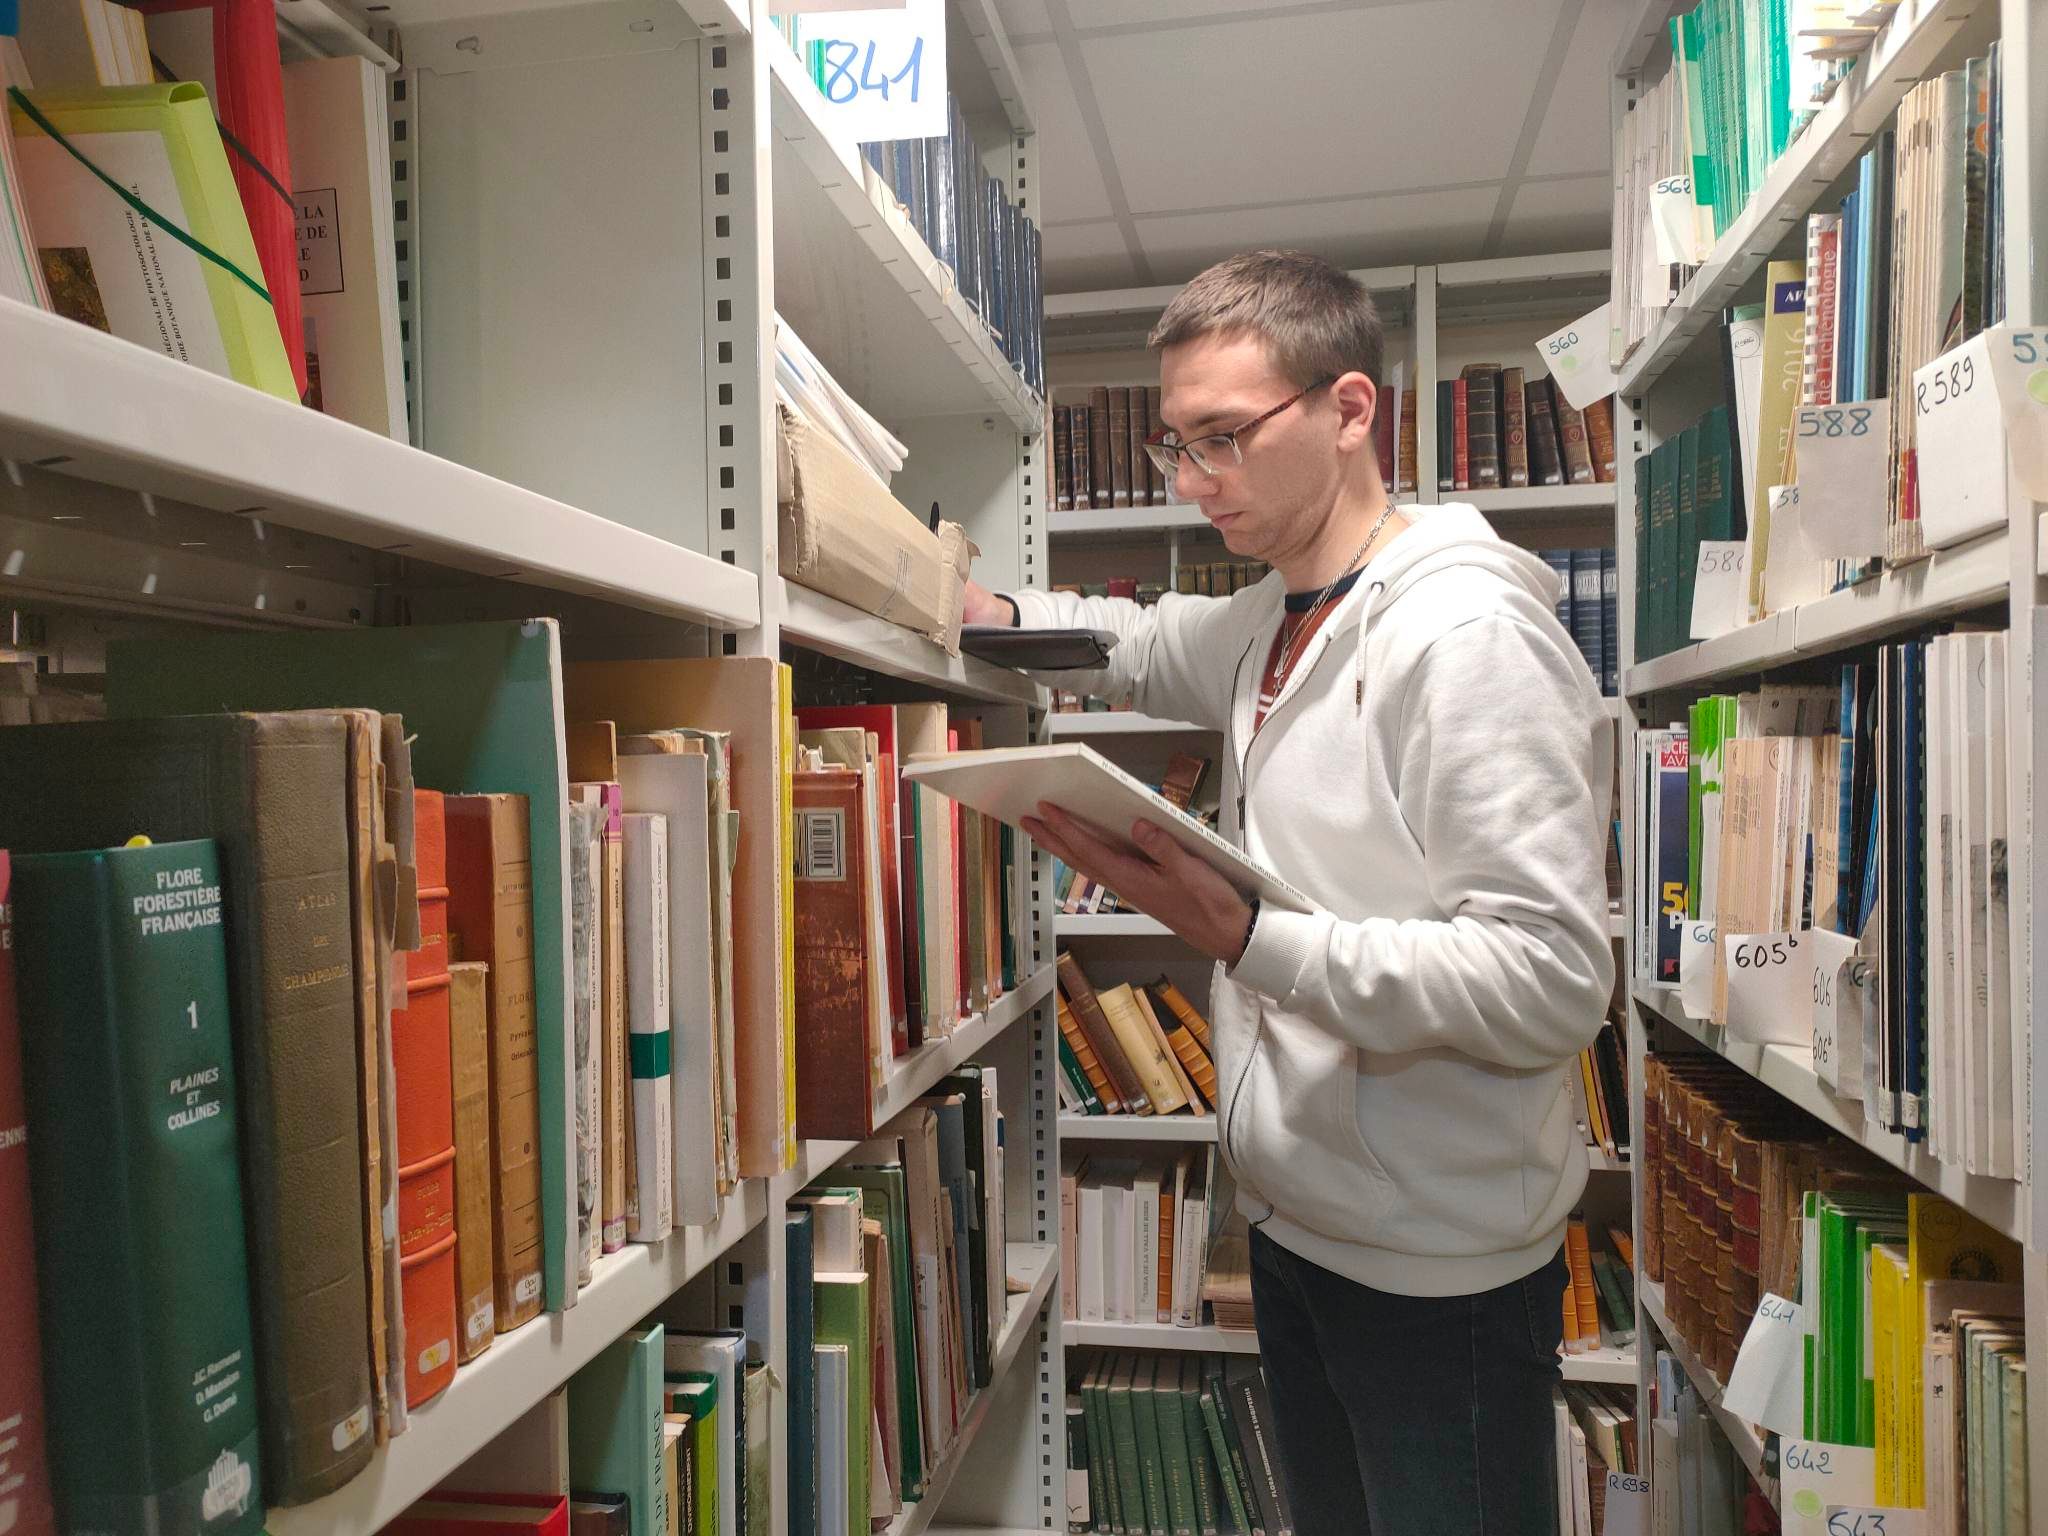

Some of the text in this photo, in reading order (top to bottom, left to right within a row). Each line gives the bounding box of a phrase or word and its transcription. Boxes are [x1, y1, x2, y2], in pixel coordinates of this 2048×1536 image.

[825, 37, 924, 104] 841
[303, 205, 324, 220] LA
[306, 225, 328, 240] DE
[1549, 330, 1580, 356] 560
[1815, 378, 1833, 402] de
[1917, 355, 1975, 418] R 589
[1798, 408, 1873, 437] 588
[156, 868, 203, 890] FLORE
[133, 885, 222, 916] FORESTIÈRE
[141, 906, 221, 937] FRANÇAISE
[1812, 965, 1832, 1007] 606
[187, 1001, 199, 1030] 1
[169, 1066, 220, 1095] PLAINES
[187, 1090, 201, 1105] ET
[167, 1100, 221, 1131] COLLINES
[1759, 1300, 1796, 1324] 641
[652, 1405, 663, 1486] FRANCE
[1785, 1443, 1833, 1475] 642
[1609, 1474, 1650, 1494] R 698
[654, 1488, 663, 1518] DE
[1827, 1511, 1886, 1536] 643
